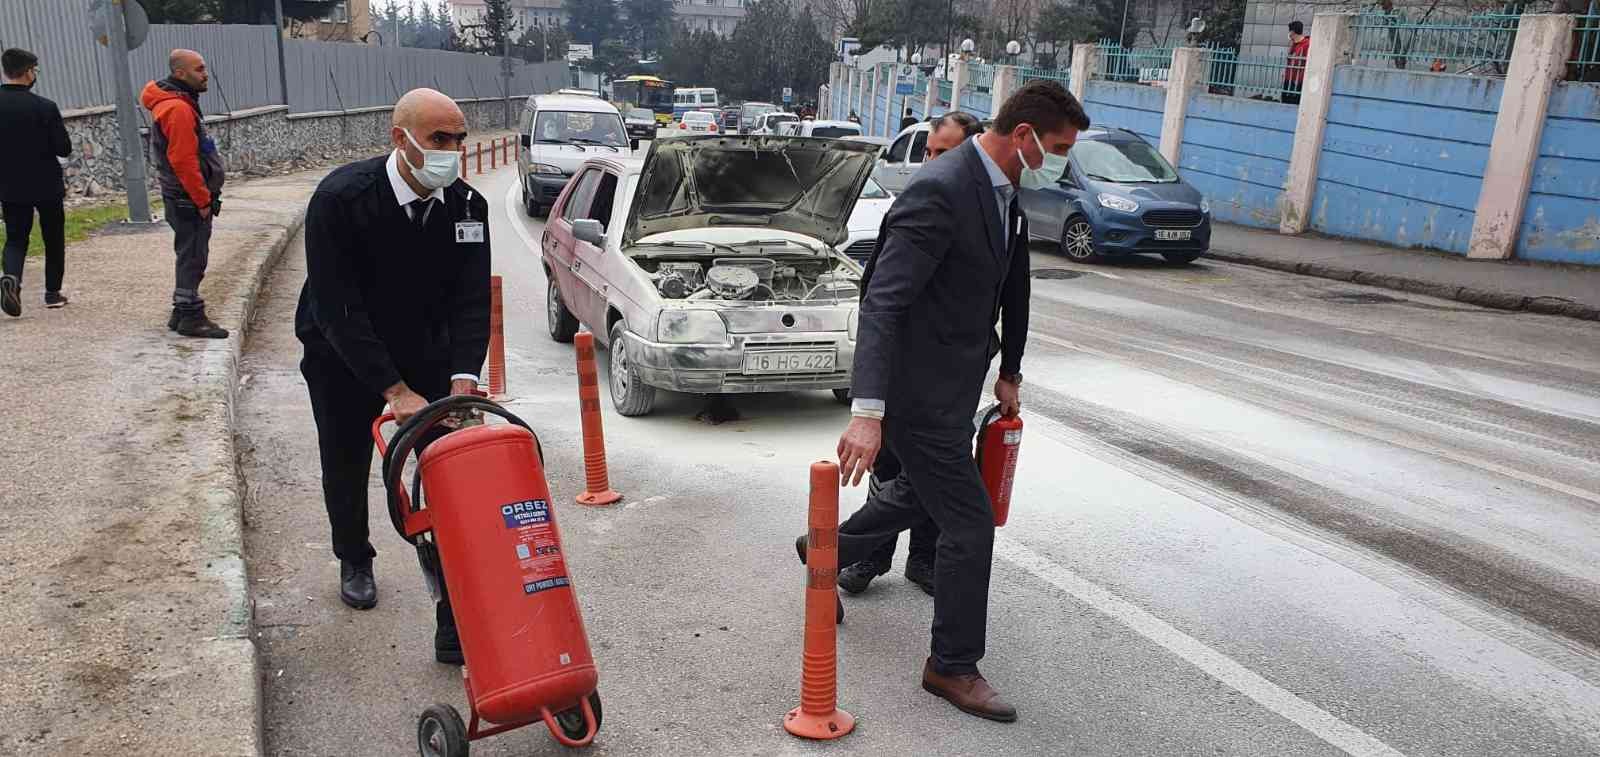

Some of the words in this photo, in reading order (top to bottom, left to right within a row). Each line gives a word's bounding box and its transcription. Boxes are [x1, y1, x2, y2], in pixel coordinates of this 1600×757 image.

[753, 356, 769, 369] 16
[778, 355, 800, 369] HG
[805, 355, 833, 369] 422
[502, 500, 548, 515] ORSEZ
